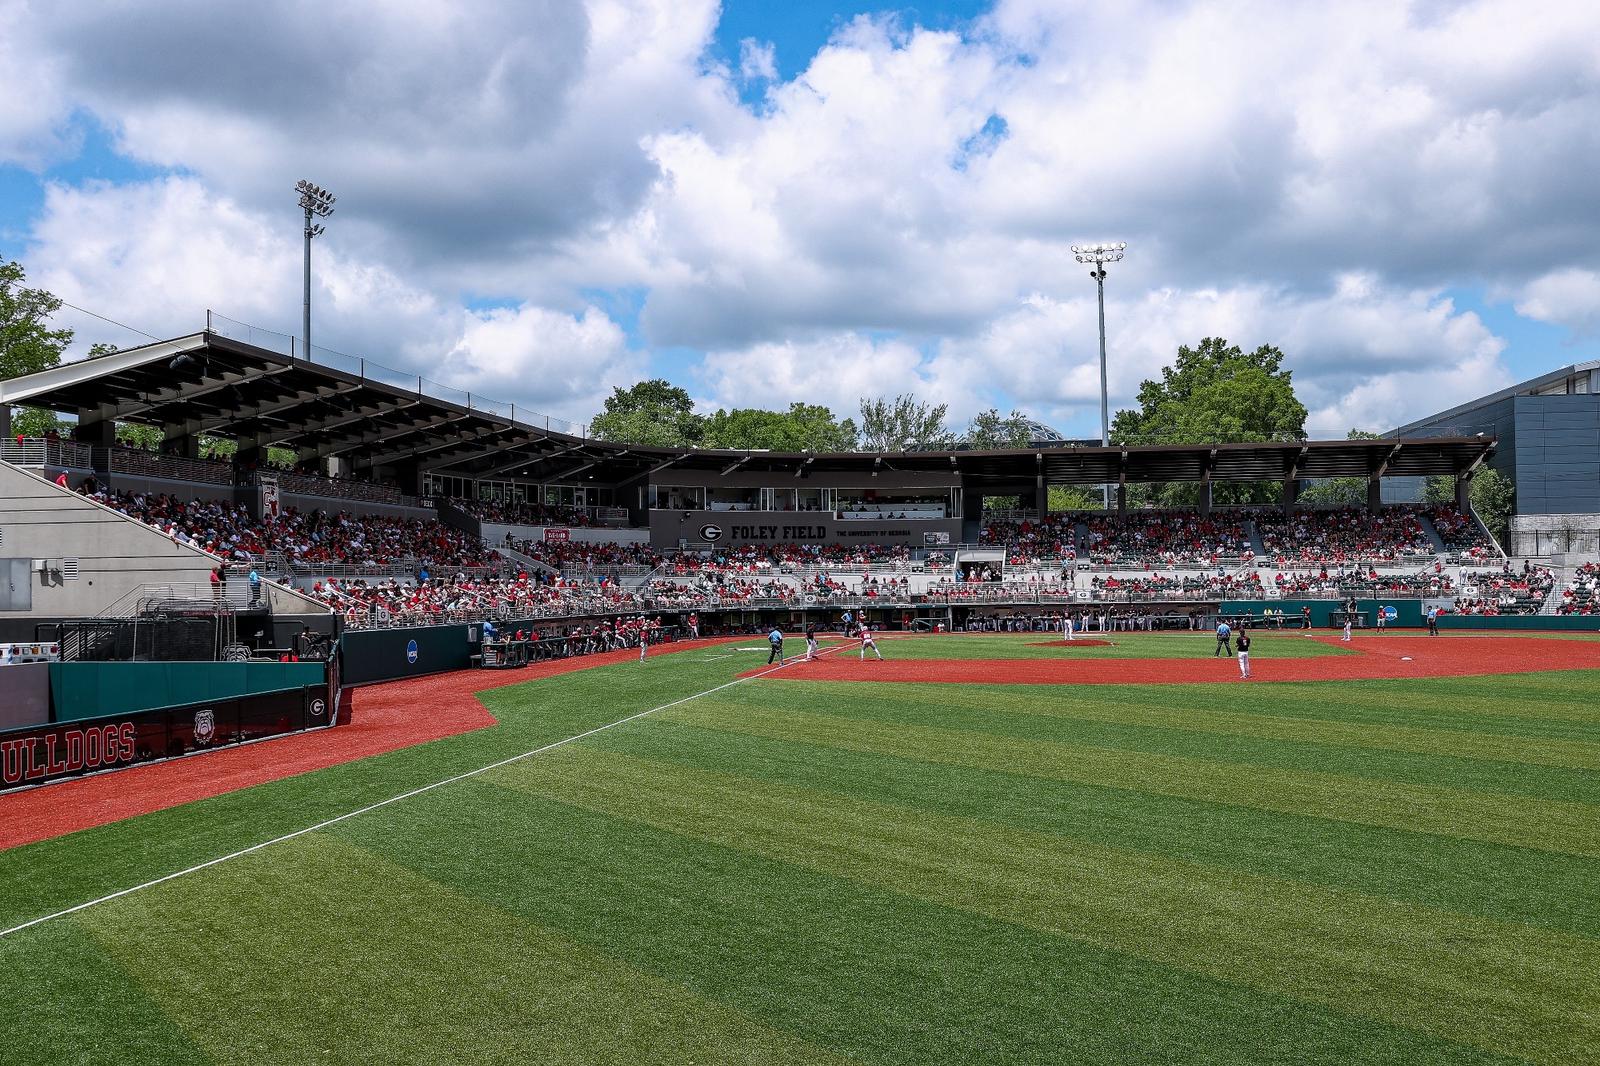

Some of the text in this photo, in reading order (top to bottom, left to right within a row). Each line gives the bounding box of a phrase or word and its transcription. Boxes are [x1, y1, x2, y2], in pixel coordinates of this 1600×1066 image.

[699, 524, 723, 542] G
[731, 526, 827, 540] FOLEY FIELD
[310, 699, 325, 716] G
[1, 722, 135, 784] ULLDOGS
